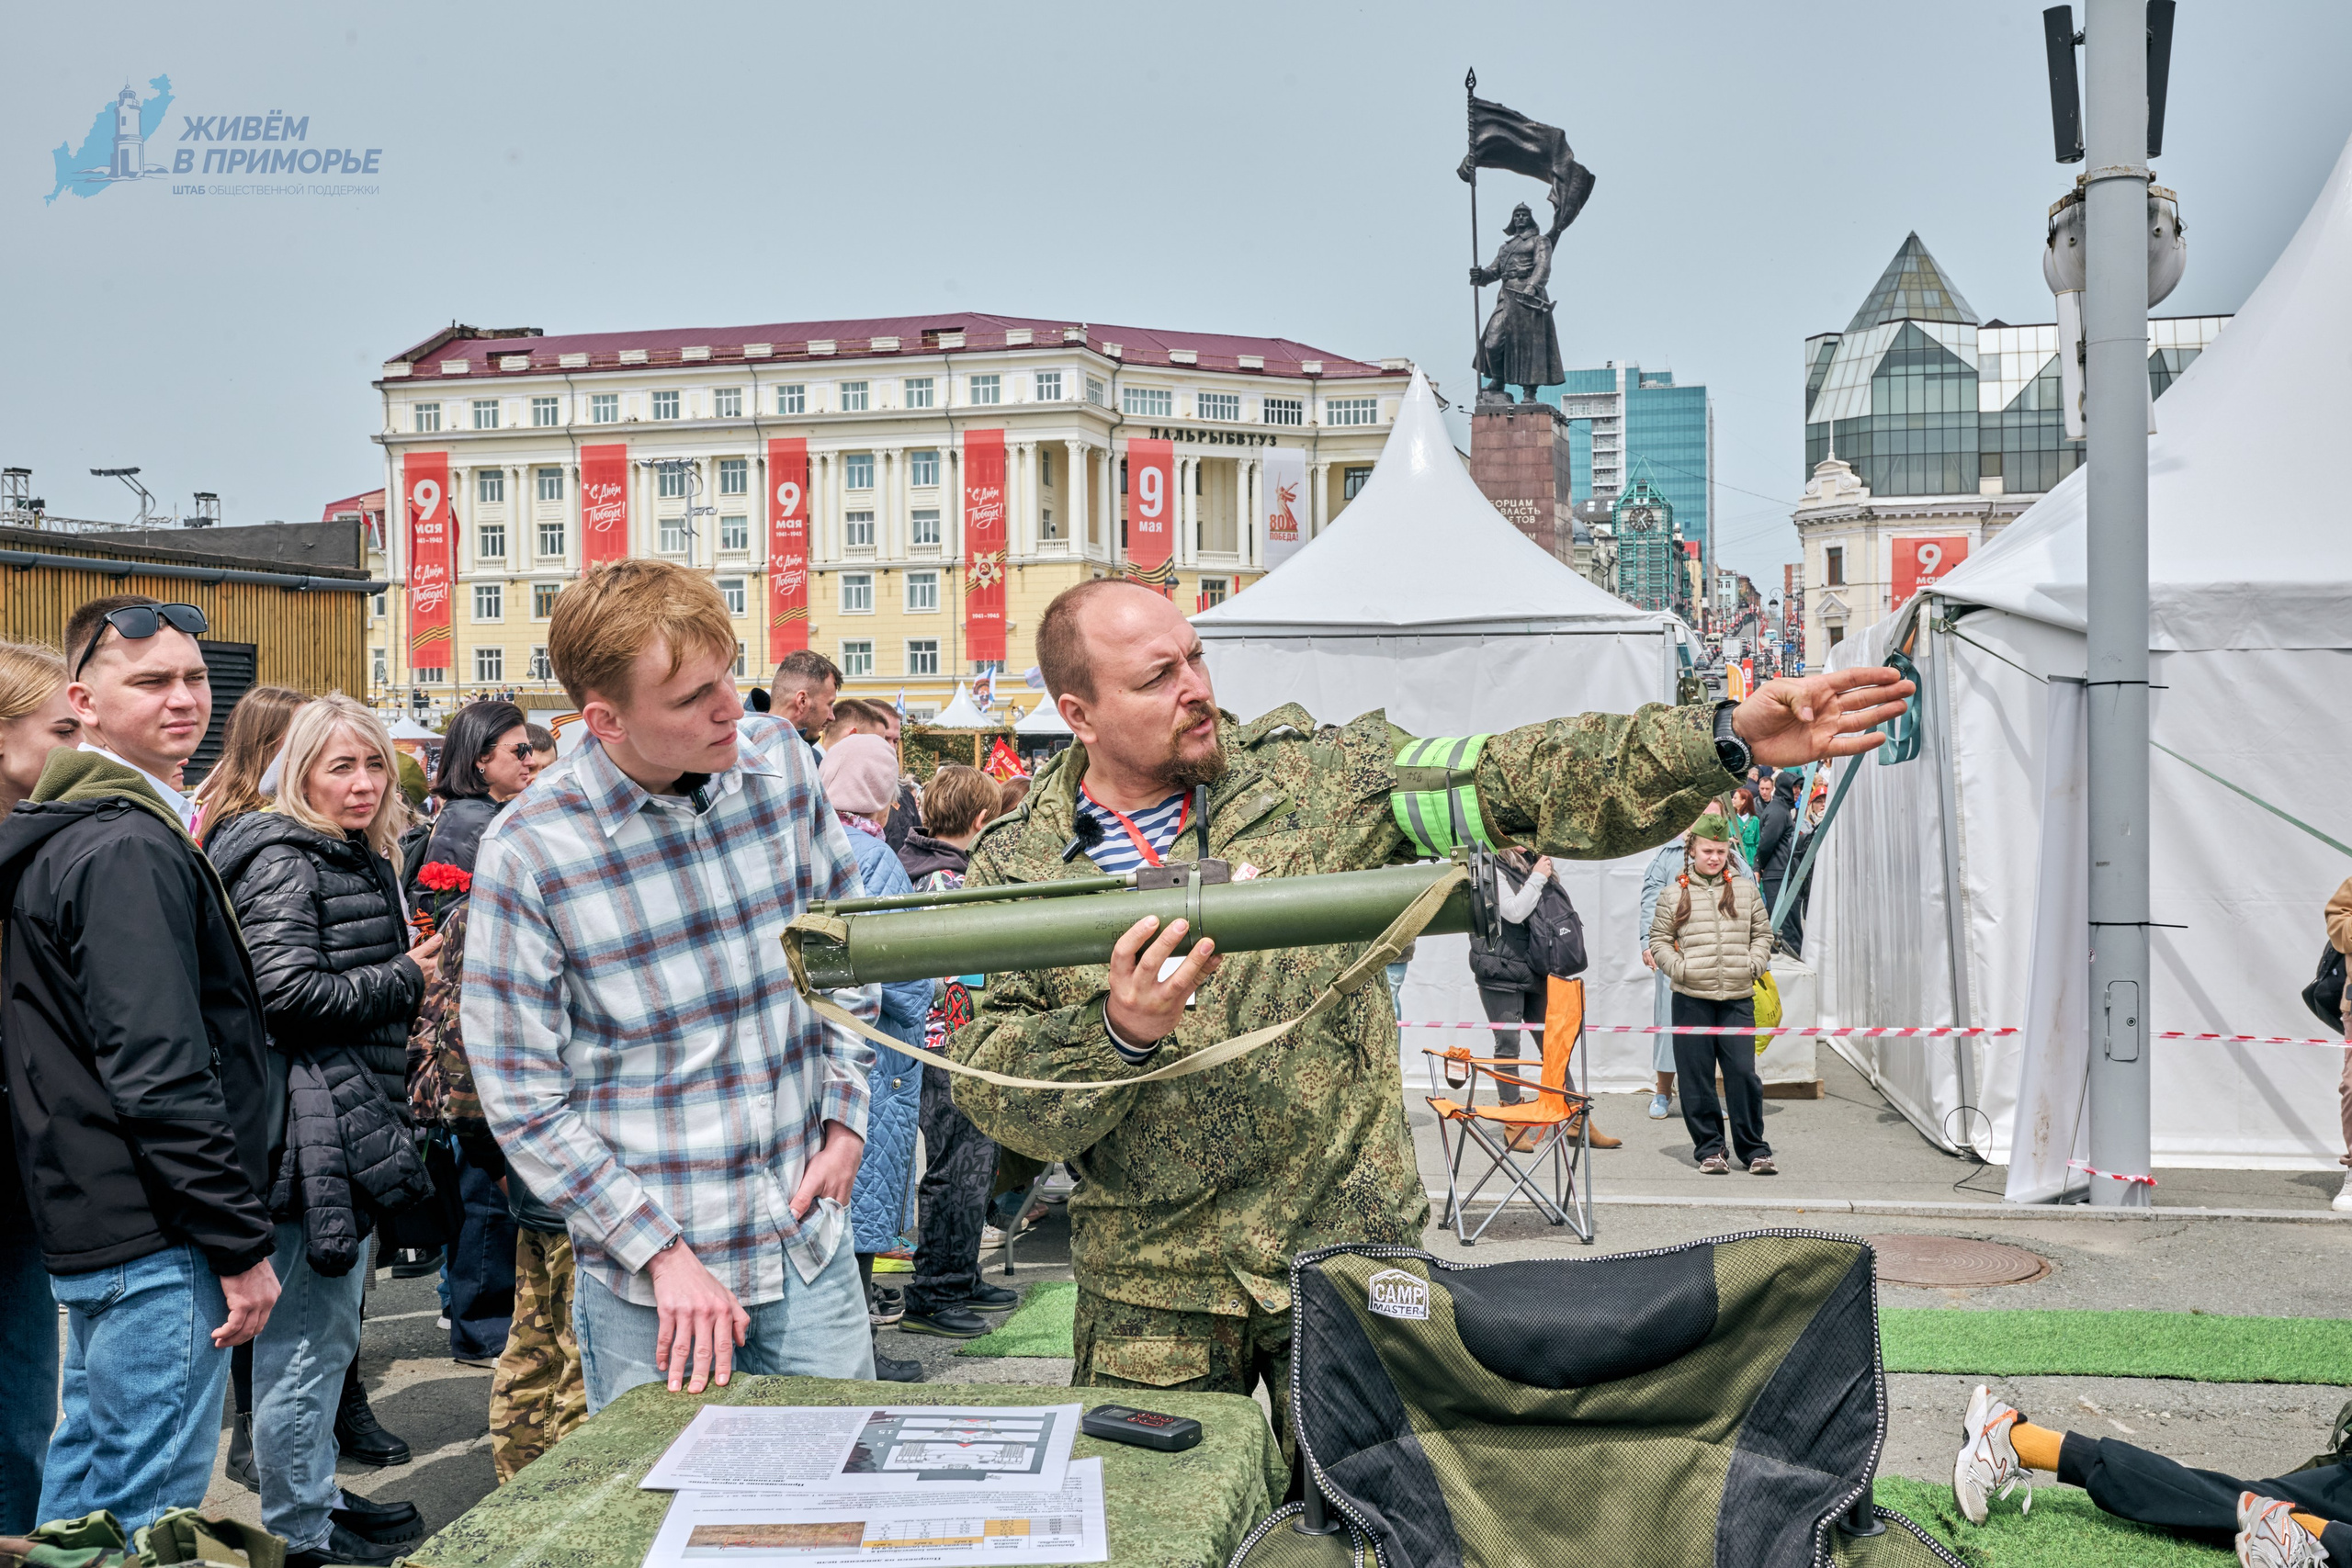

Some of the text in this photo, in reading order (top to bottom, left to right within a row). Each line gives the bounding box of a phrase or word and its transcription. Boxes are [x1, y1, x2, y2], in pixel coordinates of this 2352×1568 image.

[1149, 427, 1278, 446] ДАЛЬРЫБВТУЗ
[413, 479, 441, 520] 9
[589, 483, 621, 504] С Днём
[776, 481, 801, 517] 9
[971, 487, 999, 505] С Днём
[1139, 467, 1164, 517] 9
[583, 501, 626, 532] Победы!
[967, 502, 1003, 529] Победы!
[1500, 507, 1541, 515] ВЛАСТЬ
[1509, 515, 1535, 524] ЕТОВ
[775, 519, 802, 529] мая
[1139, 521, 1162, 534] мая
[1270, 514, 1284, 530] 80
[1270, 533, 1298, 542] ПОБЕДА!
[775, 554, 802, 572] С Днём
[1917, 543, 1942, 574] 9
[413, 564, 444, 585] С Днём
[771, 570, 806, 595] Победы!
[407, 581, 448, 613] Победы!
[1375, 1284, 1423, 1304] CAMP
[1374, 1303, 1419, 1315] MASTER
